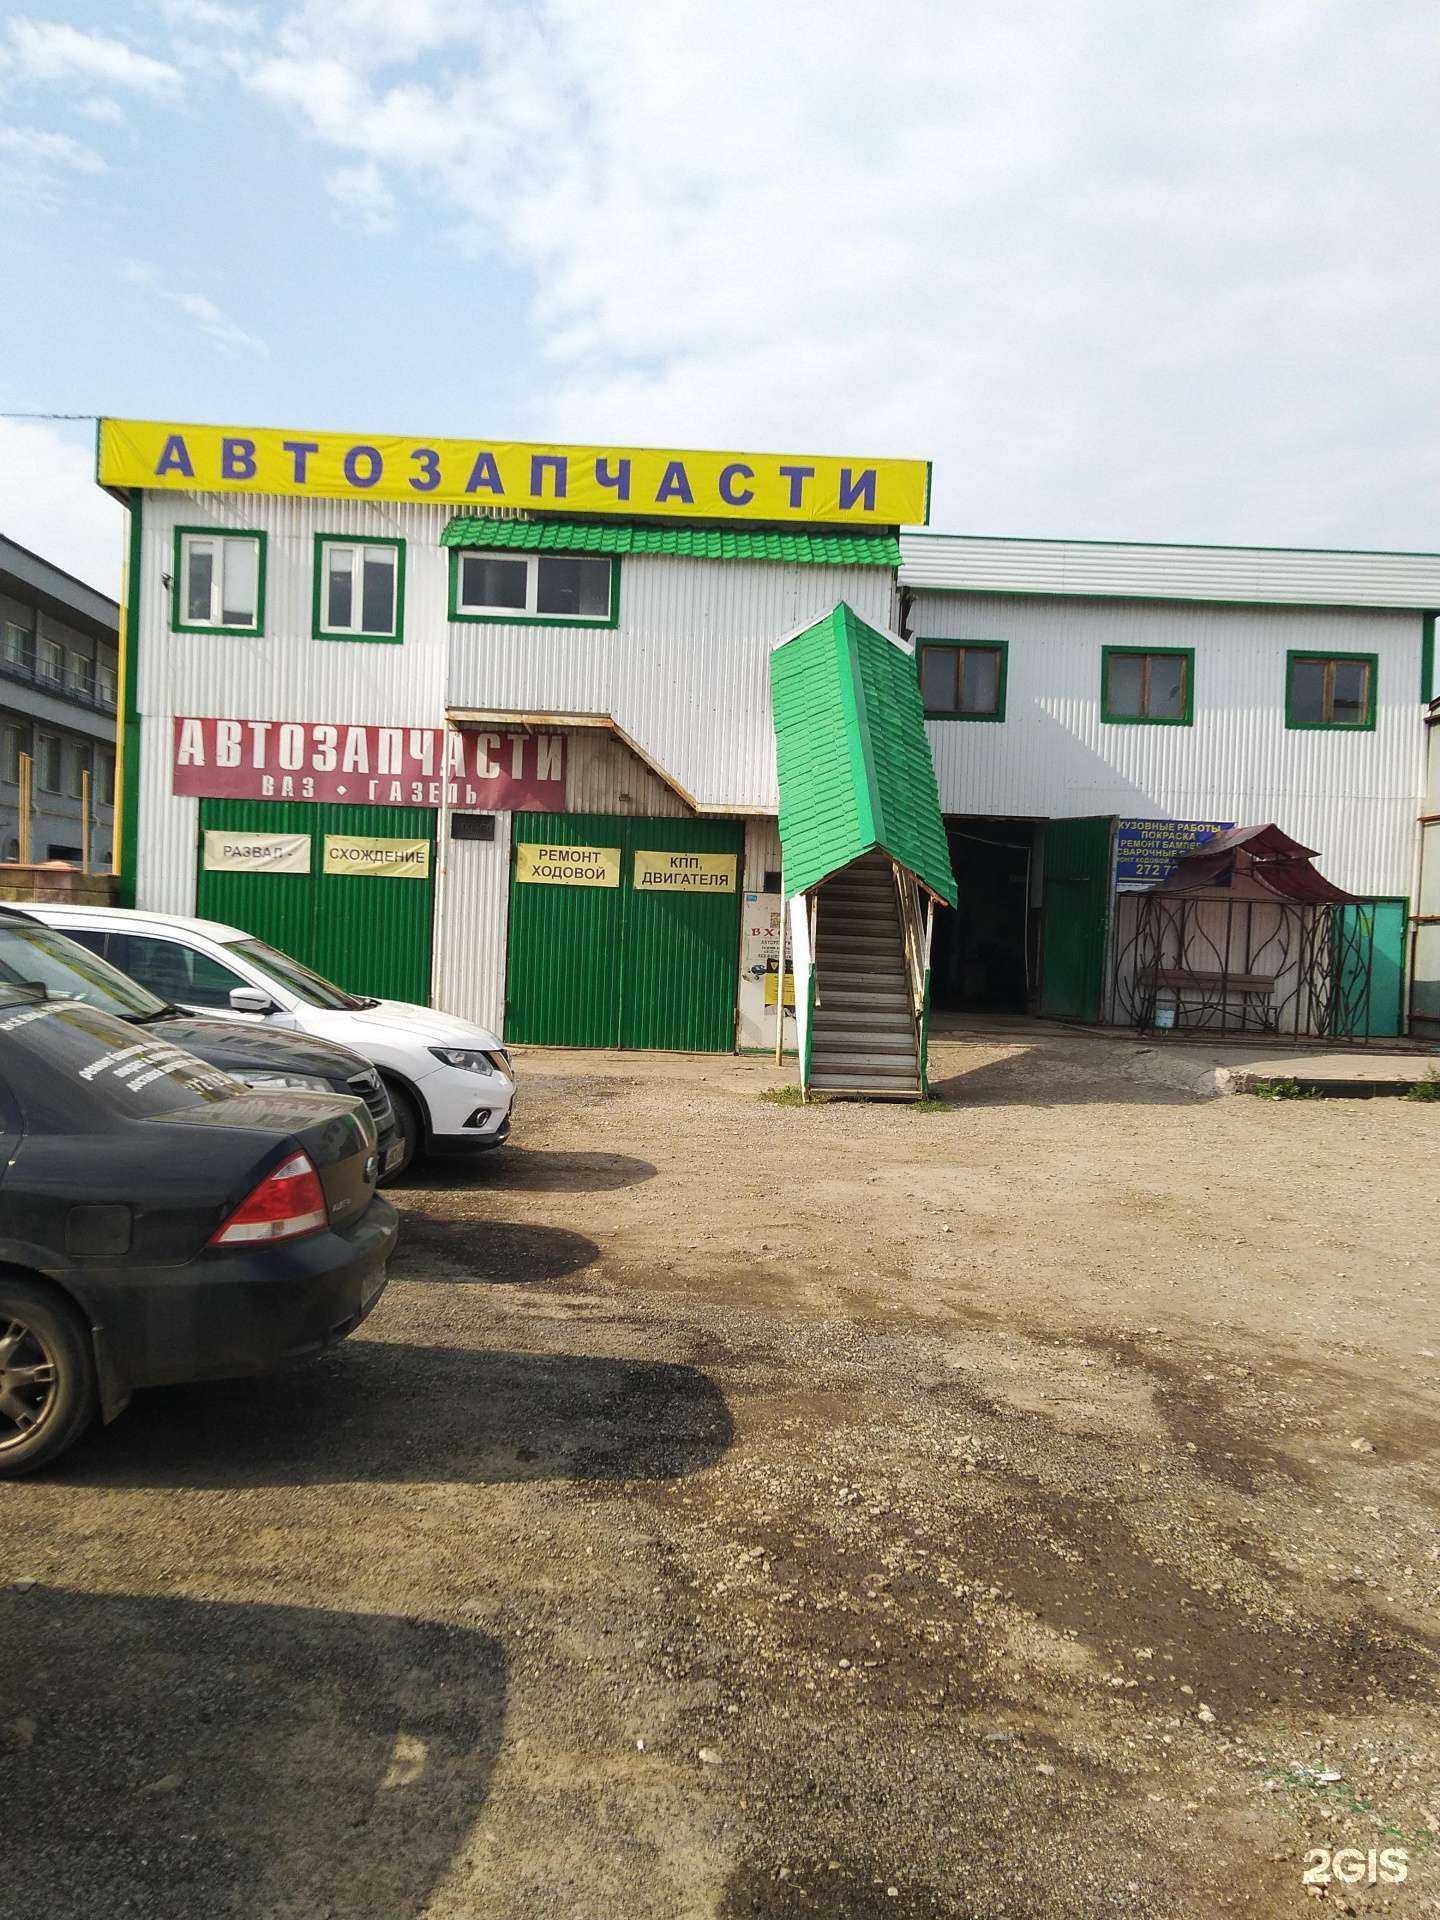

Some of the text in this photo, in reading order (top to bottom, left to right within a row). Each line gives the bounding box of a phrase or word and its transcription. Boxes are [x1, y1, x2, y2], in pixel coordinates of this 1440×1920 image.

[153, 432, 879, 512] АВТОЗАПЧАСТИ
[176, 718, 564, 782] АВТОЗАПЧАСТИ
[261, 774, 478, 806] ВАЗ ГАЗЕЛЬ
[1118, 821, 1221, 833] КУЗОВНЫЕ РАБОТЫ
[1141, 830, 1197, 841] ПОКРАСКА
[1120, 839, 1161, 849] РЕМОНТ
[329, 847, 426, 865] СХОЖДЕНИЕ
[538, 848, 601, 864] РЕМОНТ
[669, 856, 703, 870] КПП,
[532, 864, 606, 881] ХОДОВОЙ
[1135, 864, 1160, 876] 272
[641, 871, 729, 887] ДВИГАТЕЛЯ
